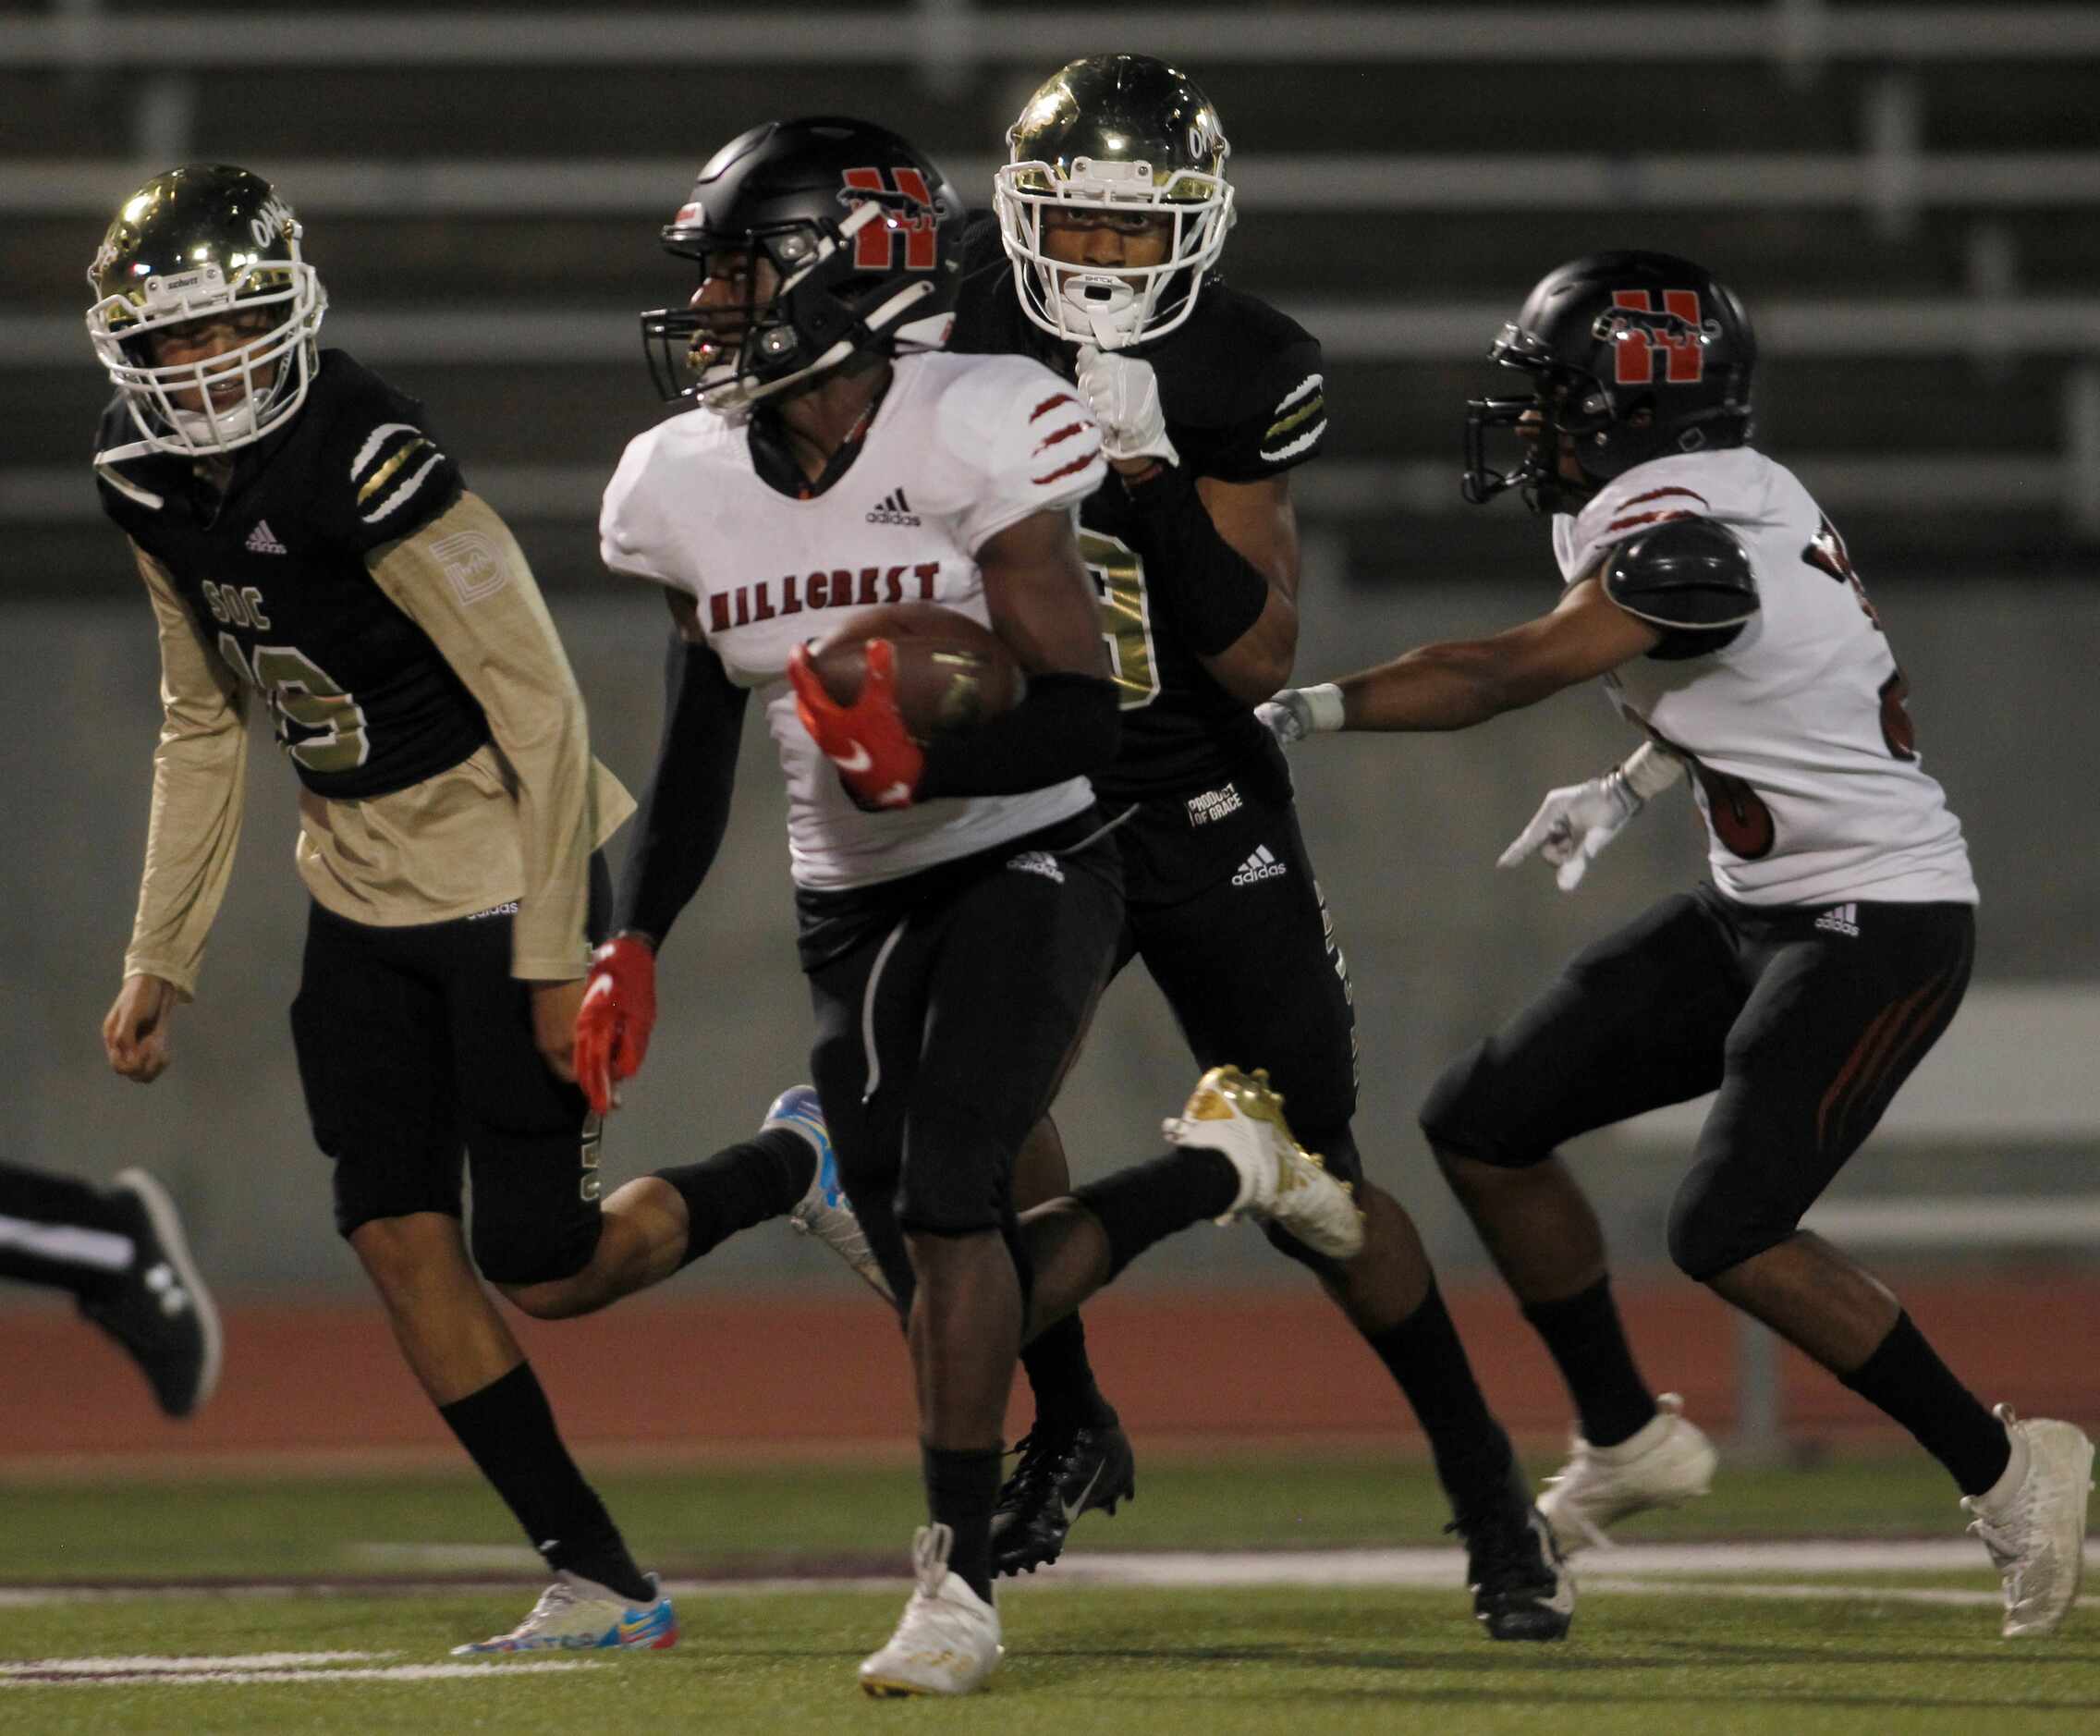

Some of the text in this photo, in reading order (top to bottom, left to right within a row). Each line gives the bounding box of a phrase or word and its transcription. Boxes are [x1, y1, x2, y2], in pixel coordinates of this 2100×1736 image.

[842, 166, 938, 270] H
[1612, 289, 1703, 384] H
[866, 511, 922, 528] adidas
[245, 540, 287, 555] adidas
[201, 580, 272, 630] SOC
[710, 560, 940, 632] HILLCREST
[1188, 782, 1236, 812] PRODUCT
[1193, 792, 1243, 825] OF GRACE
[1231, 862, 1287, 886] adidas
[1814, 917, 1860, 936] adidas
